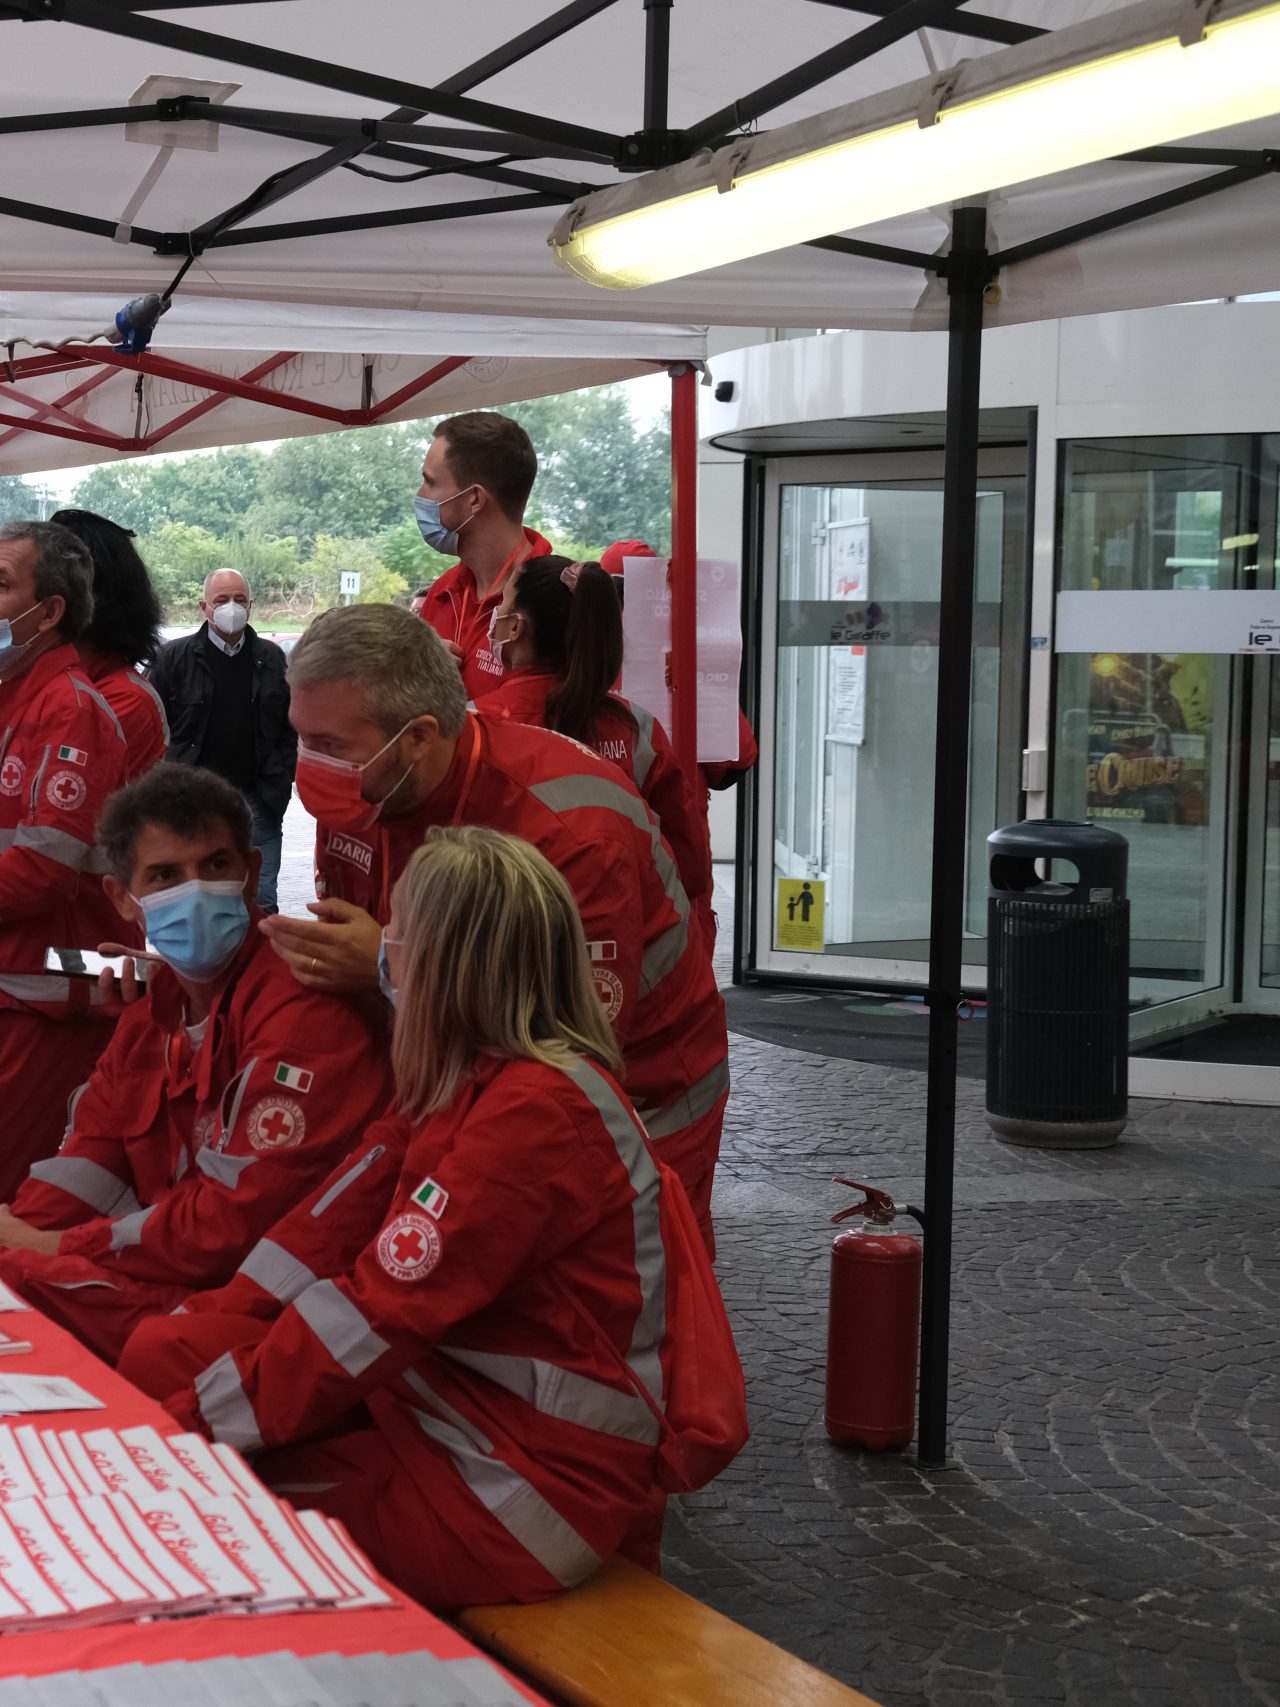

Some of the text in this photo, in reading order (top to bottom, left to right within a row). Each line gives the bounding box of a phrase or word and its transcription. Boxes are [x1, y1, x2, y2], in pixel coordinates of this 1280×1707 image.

[347, 577, 355, 589] 11
[1249, 632, 1272, 645] le
[331, 837, 370, 867] DARIO
